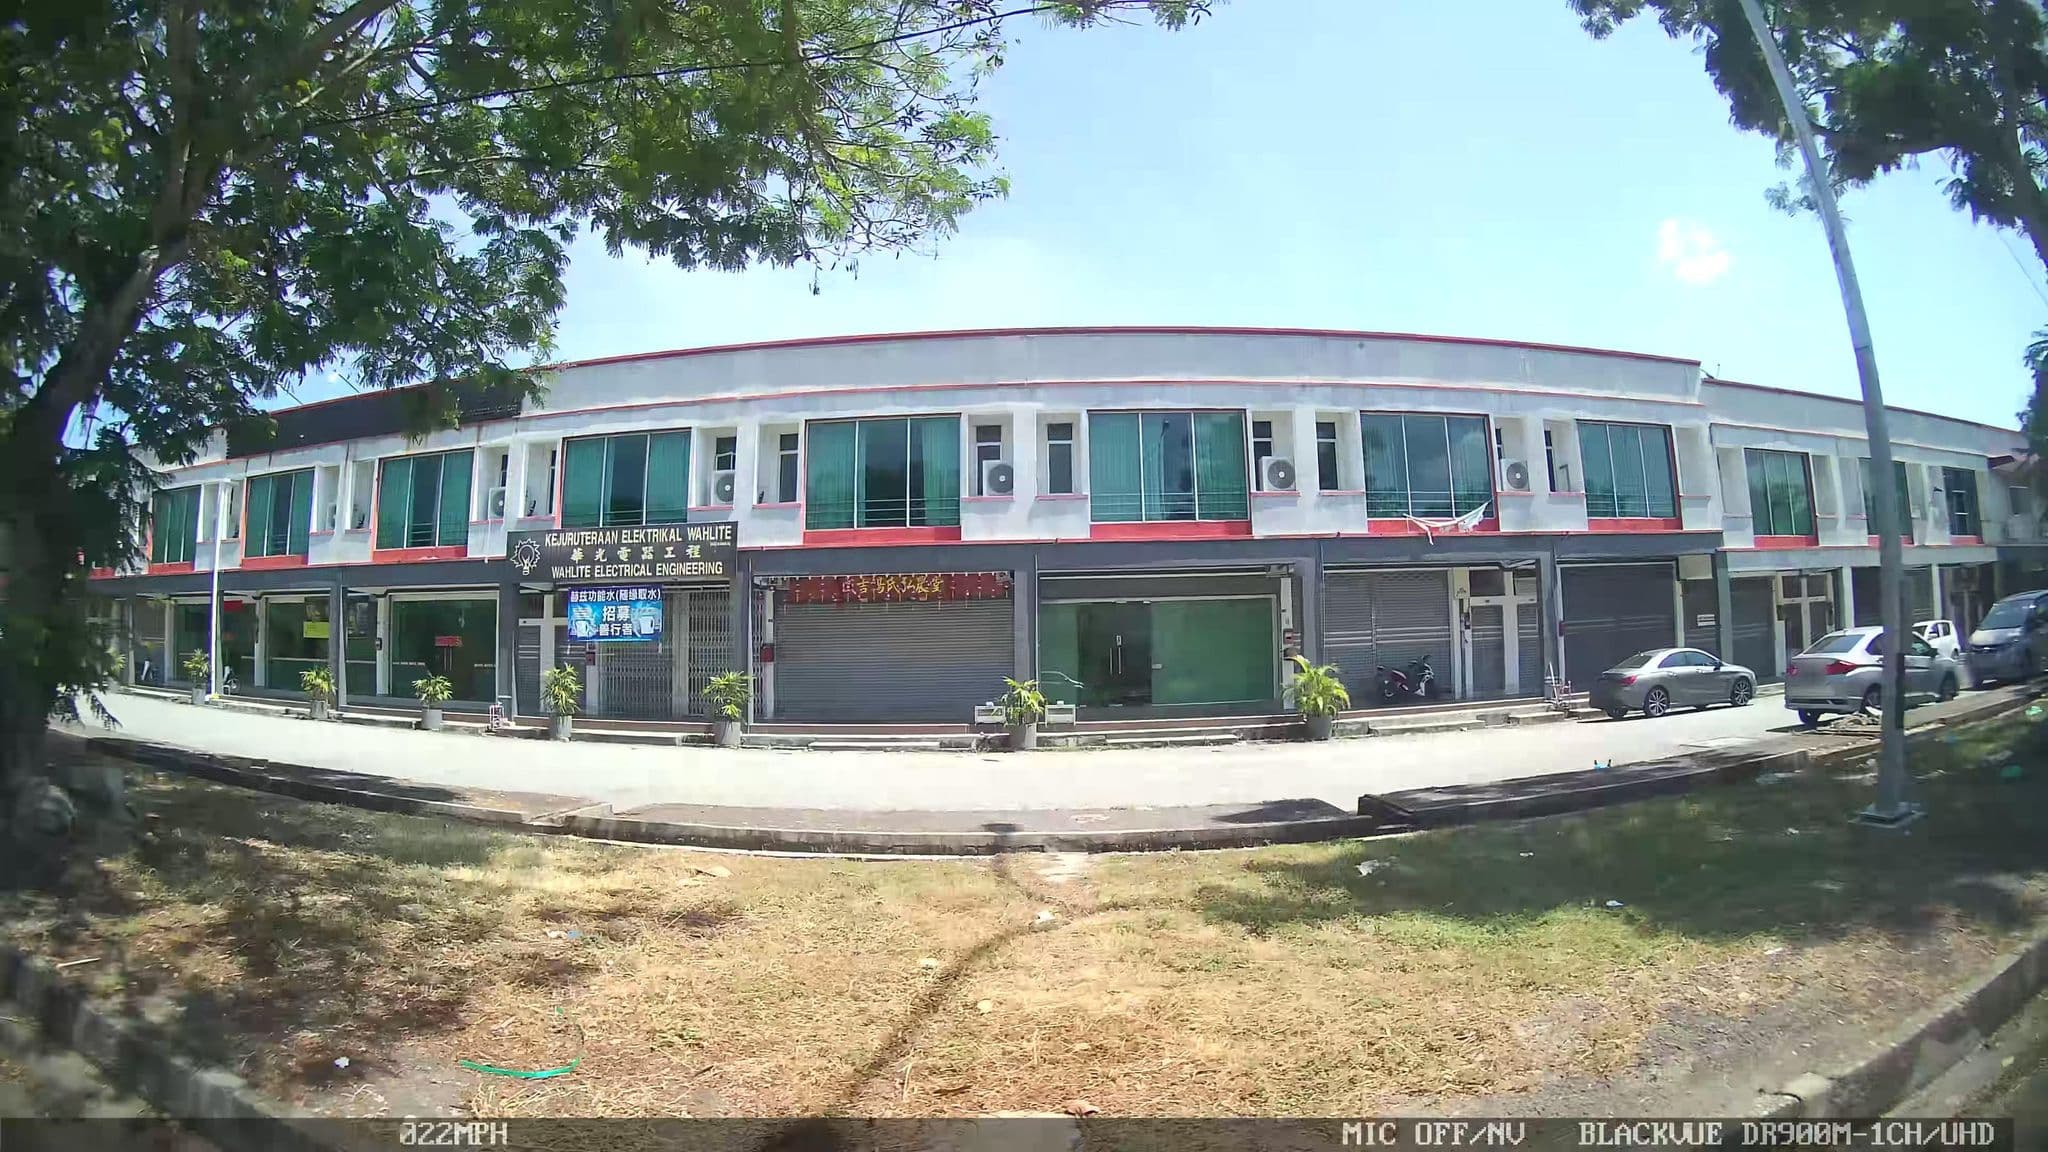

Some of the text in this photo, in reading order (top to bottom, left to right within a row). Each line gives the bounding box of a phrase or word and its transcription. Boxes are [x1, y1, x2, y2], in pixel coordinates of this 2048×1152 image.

[544, 525, 732, 547] KEJURUTERAAN ELEKTRIKAL WAHLITE
[551, 561, 723, 579] WAHLITE ELECTRICAL ENGINEERING
[602, 605, 631, 621] 招募
